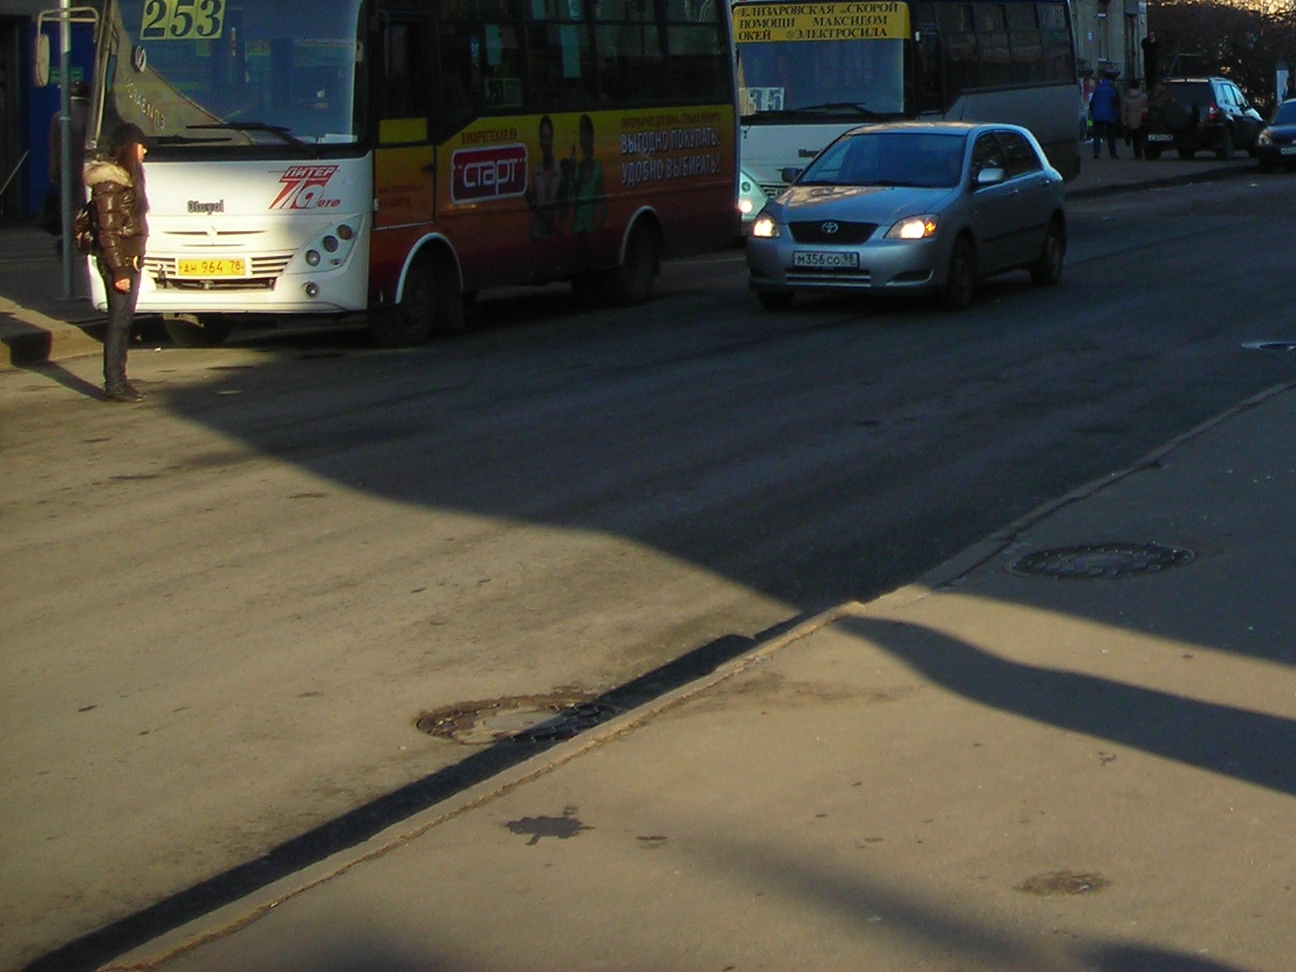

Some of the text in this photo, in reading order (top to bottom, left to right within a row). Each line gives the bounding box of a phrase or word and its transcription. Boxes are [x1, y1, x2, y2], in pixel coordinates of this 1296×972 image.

[620, 131, 669, 155] ВЫГОДНО
[285, 166, 335, 178] ПИТЕР
[621, 159, 664, 187] УДОБНО
